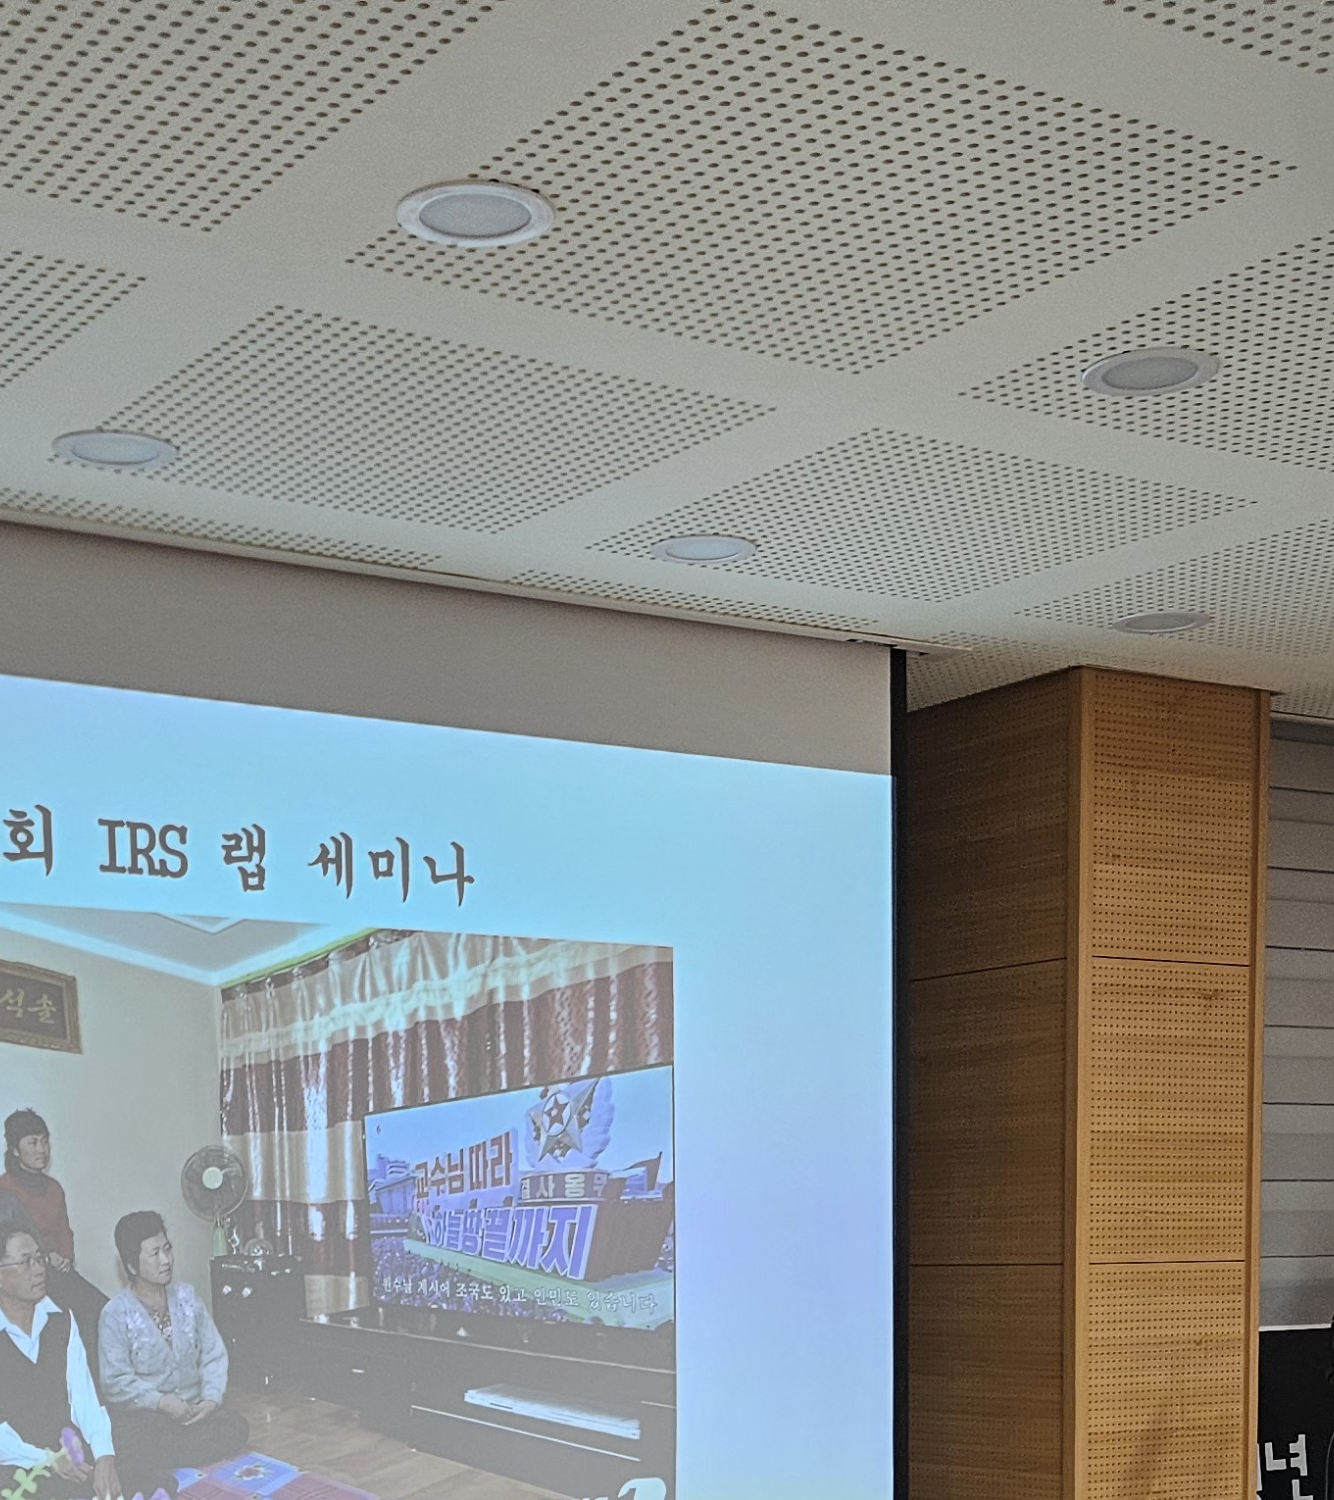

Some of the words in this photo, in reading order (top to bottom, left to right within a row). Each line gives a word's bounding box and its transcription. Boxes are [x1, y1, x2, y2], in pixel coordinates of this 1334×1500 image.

[97, 817, 189, 879] IRS
[221, 823, 268, 892] 랩
[306, 831, 475, 907] 세미나
[415, 1147, 465, 1200] 교수님
[467, 1130, 514, 1192] 따라
